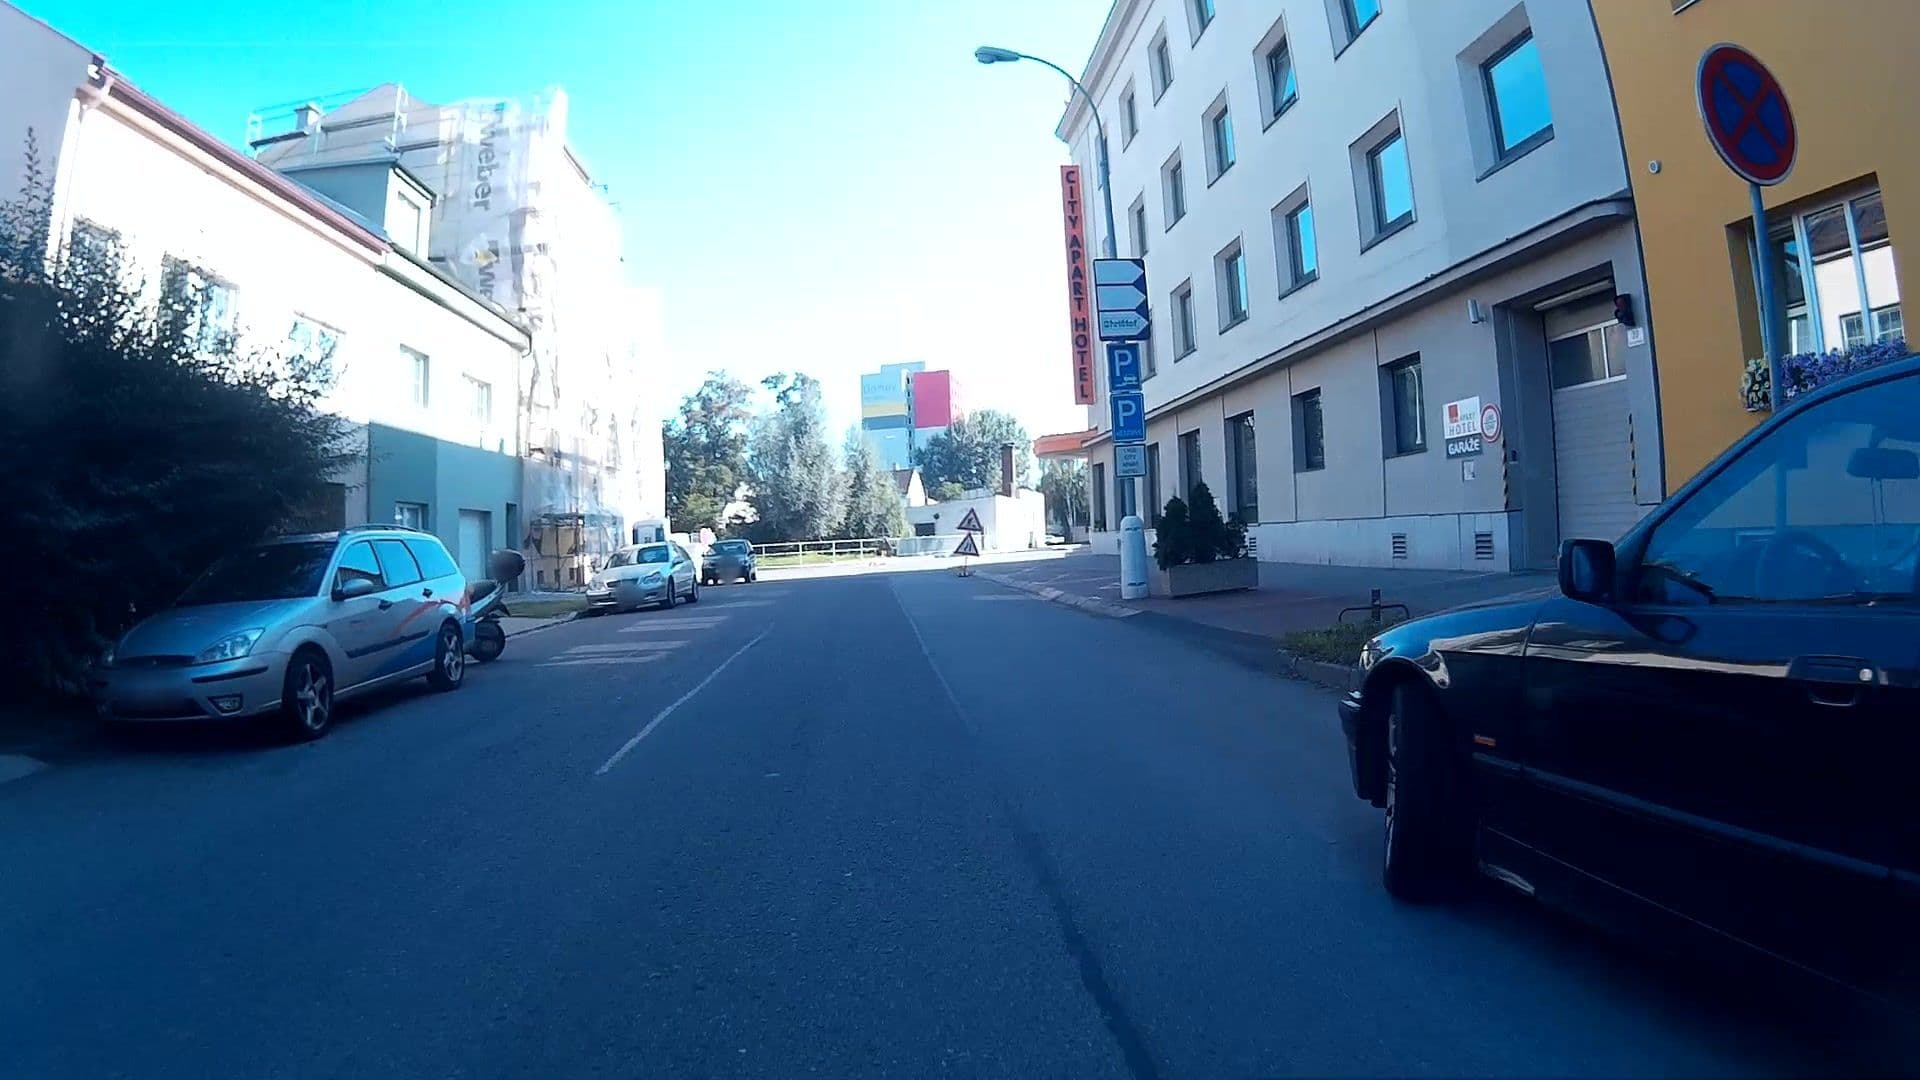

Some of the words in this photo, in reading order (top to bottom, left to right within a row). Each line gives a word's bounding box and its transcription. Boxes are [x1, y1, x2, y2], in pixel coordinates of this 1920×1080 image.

[474, 128, 499, 211] weber
[1065, 170, 1079, 229] CITY
[1069, 234, 1084, 312] APART
[1075, 317, 1088, 398] HOTEL
[1114, 349, 1133, 377] P
[1118, 400, 1136, 427] P
[1449, 422, 1477, 436] HOTEL
